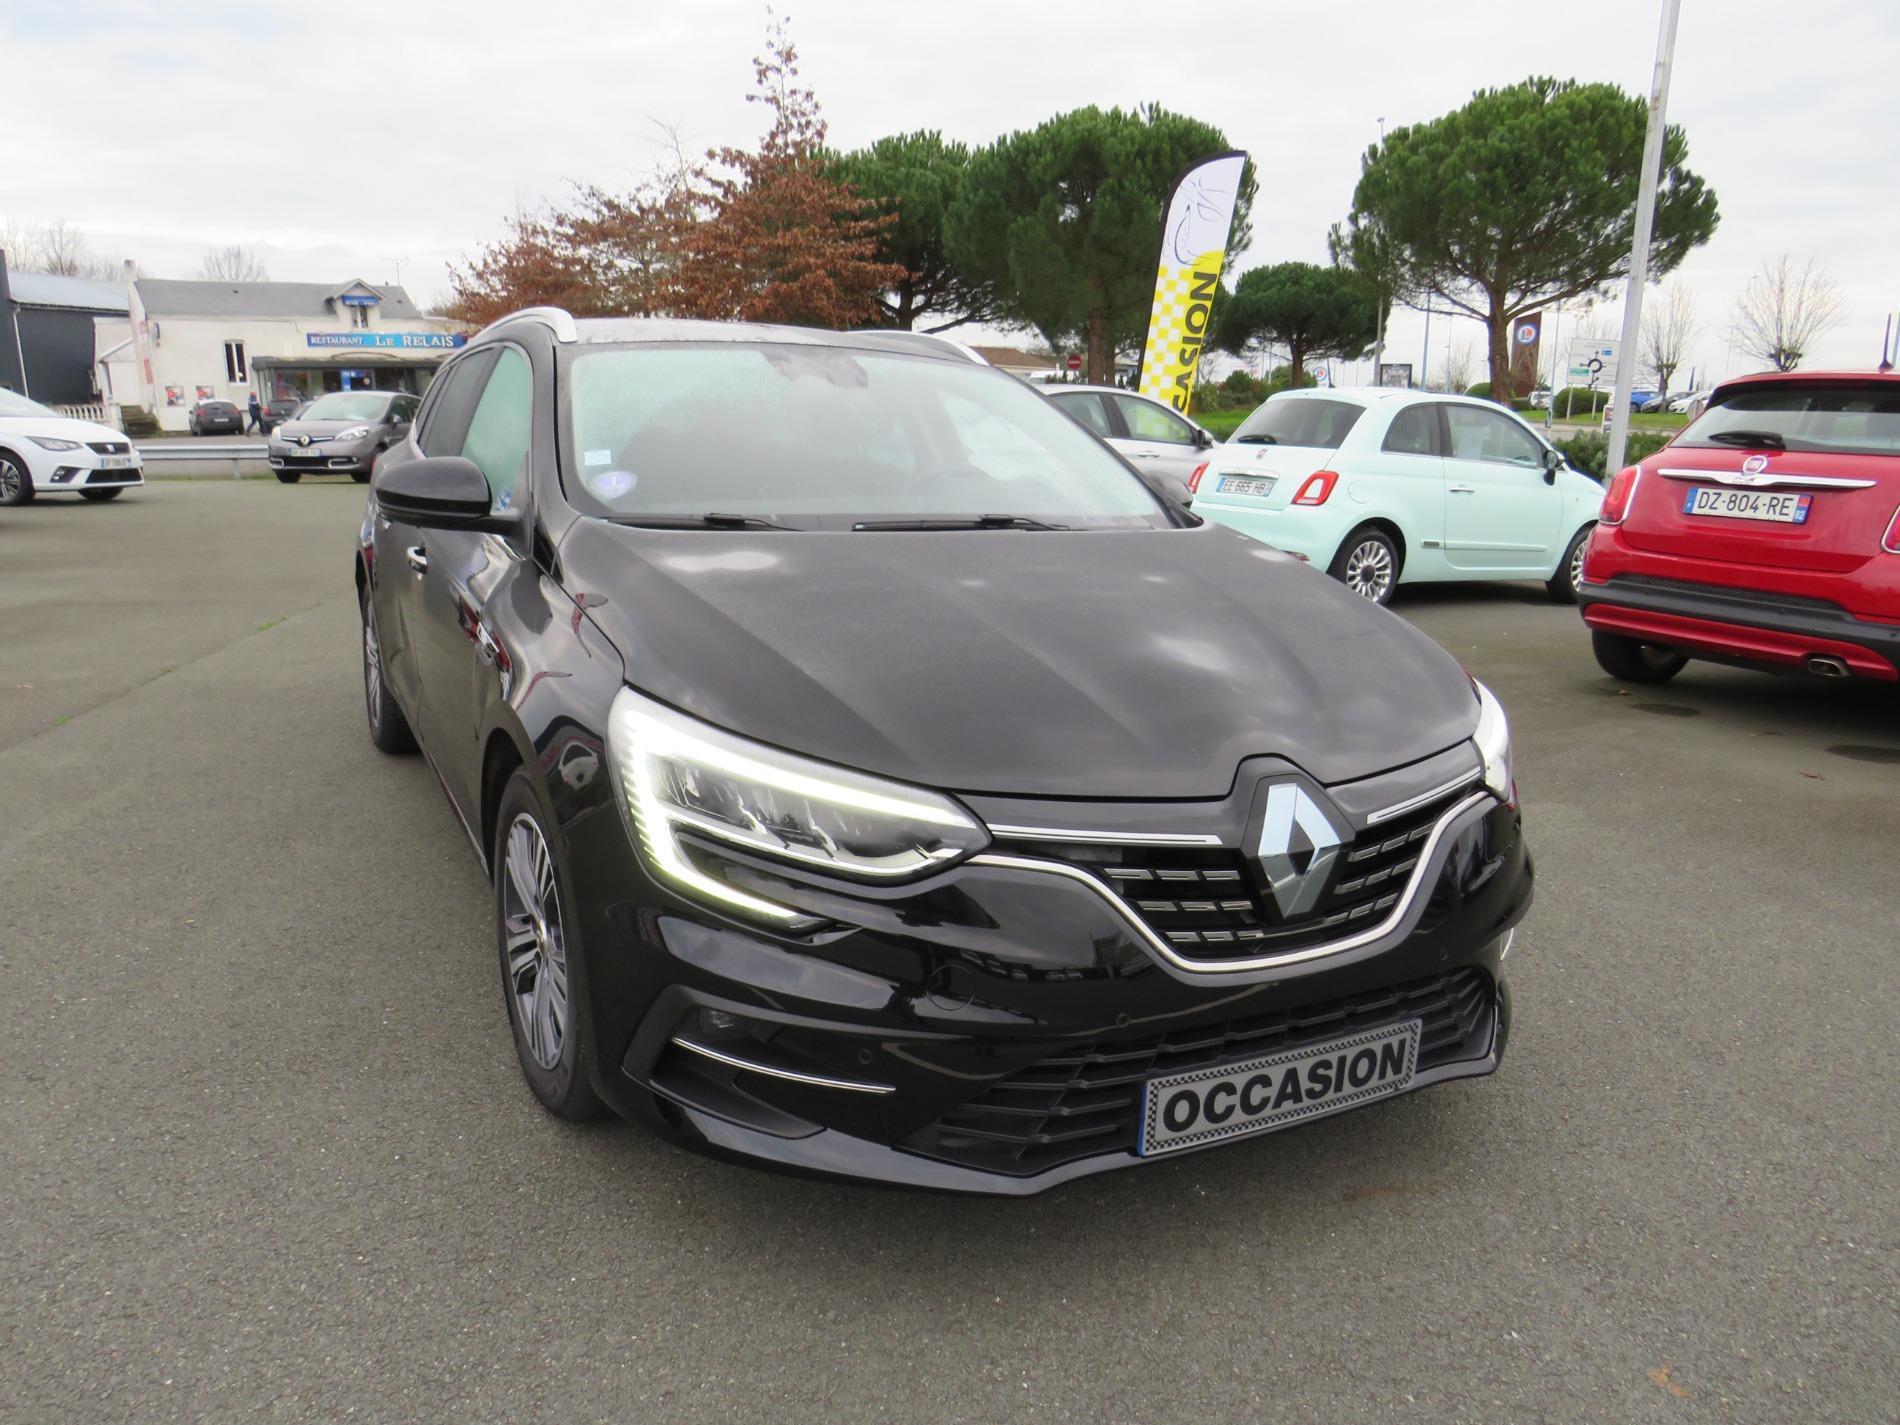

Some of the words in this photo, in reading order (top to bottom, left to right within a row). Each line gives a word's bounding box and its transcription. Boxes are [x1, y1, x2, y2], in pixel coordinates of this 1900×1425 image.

[310, 336, 363, 345] RESTAURANT
[403, 335, 454, 347] RELAIS
[1163, 1038, 1407, 1132] OCCASION
